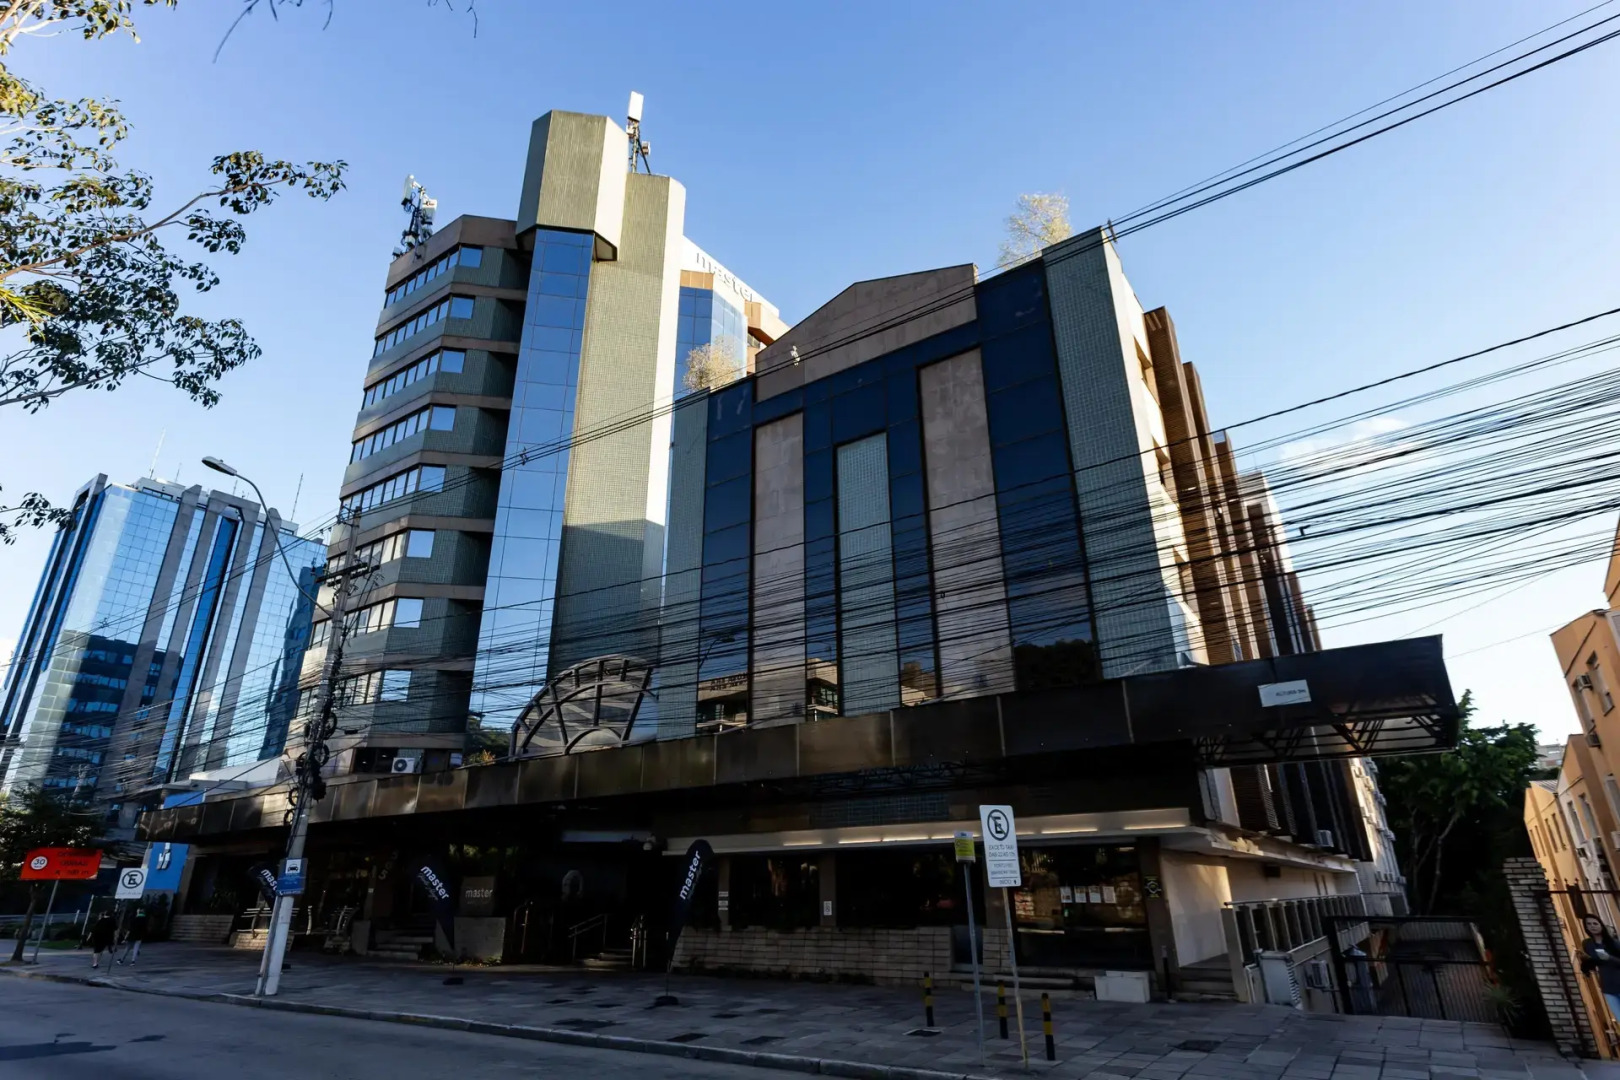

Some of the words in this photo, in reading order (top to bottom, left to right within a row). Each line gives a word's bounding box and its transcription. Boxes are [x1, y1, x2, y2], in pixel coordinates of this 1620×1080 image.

[696, 252, 754, 303] master
[420, 865, 450, 900] master
[465, 887, 493, 898] master
[679, 850, 702, 901] master
